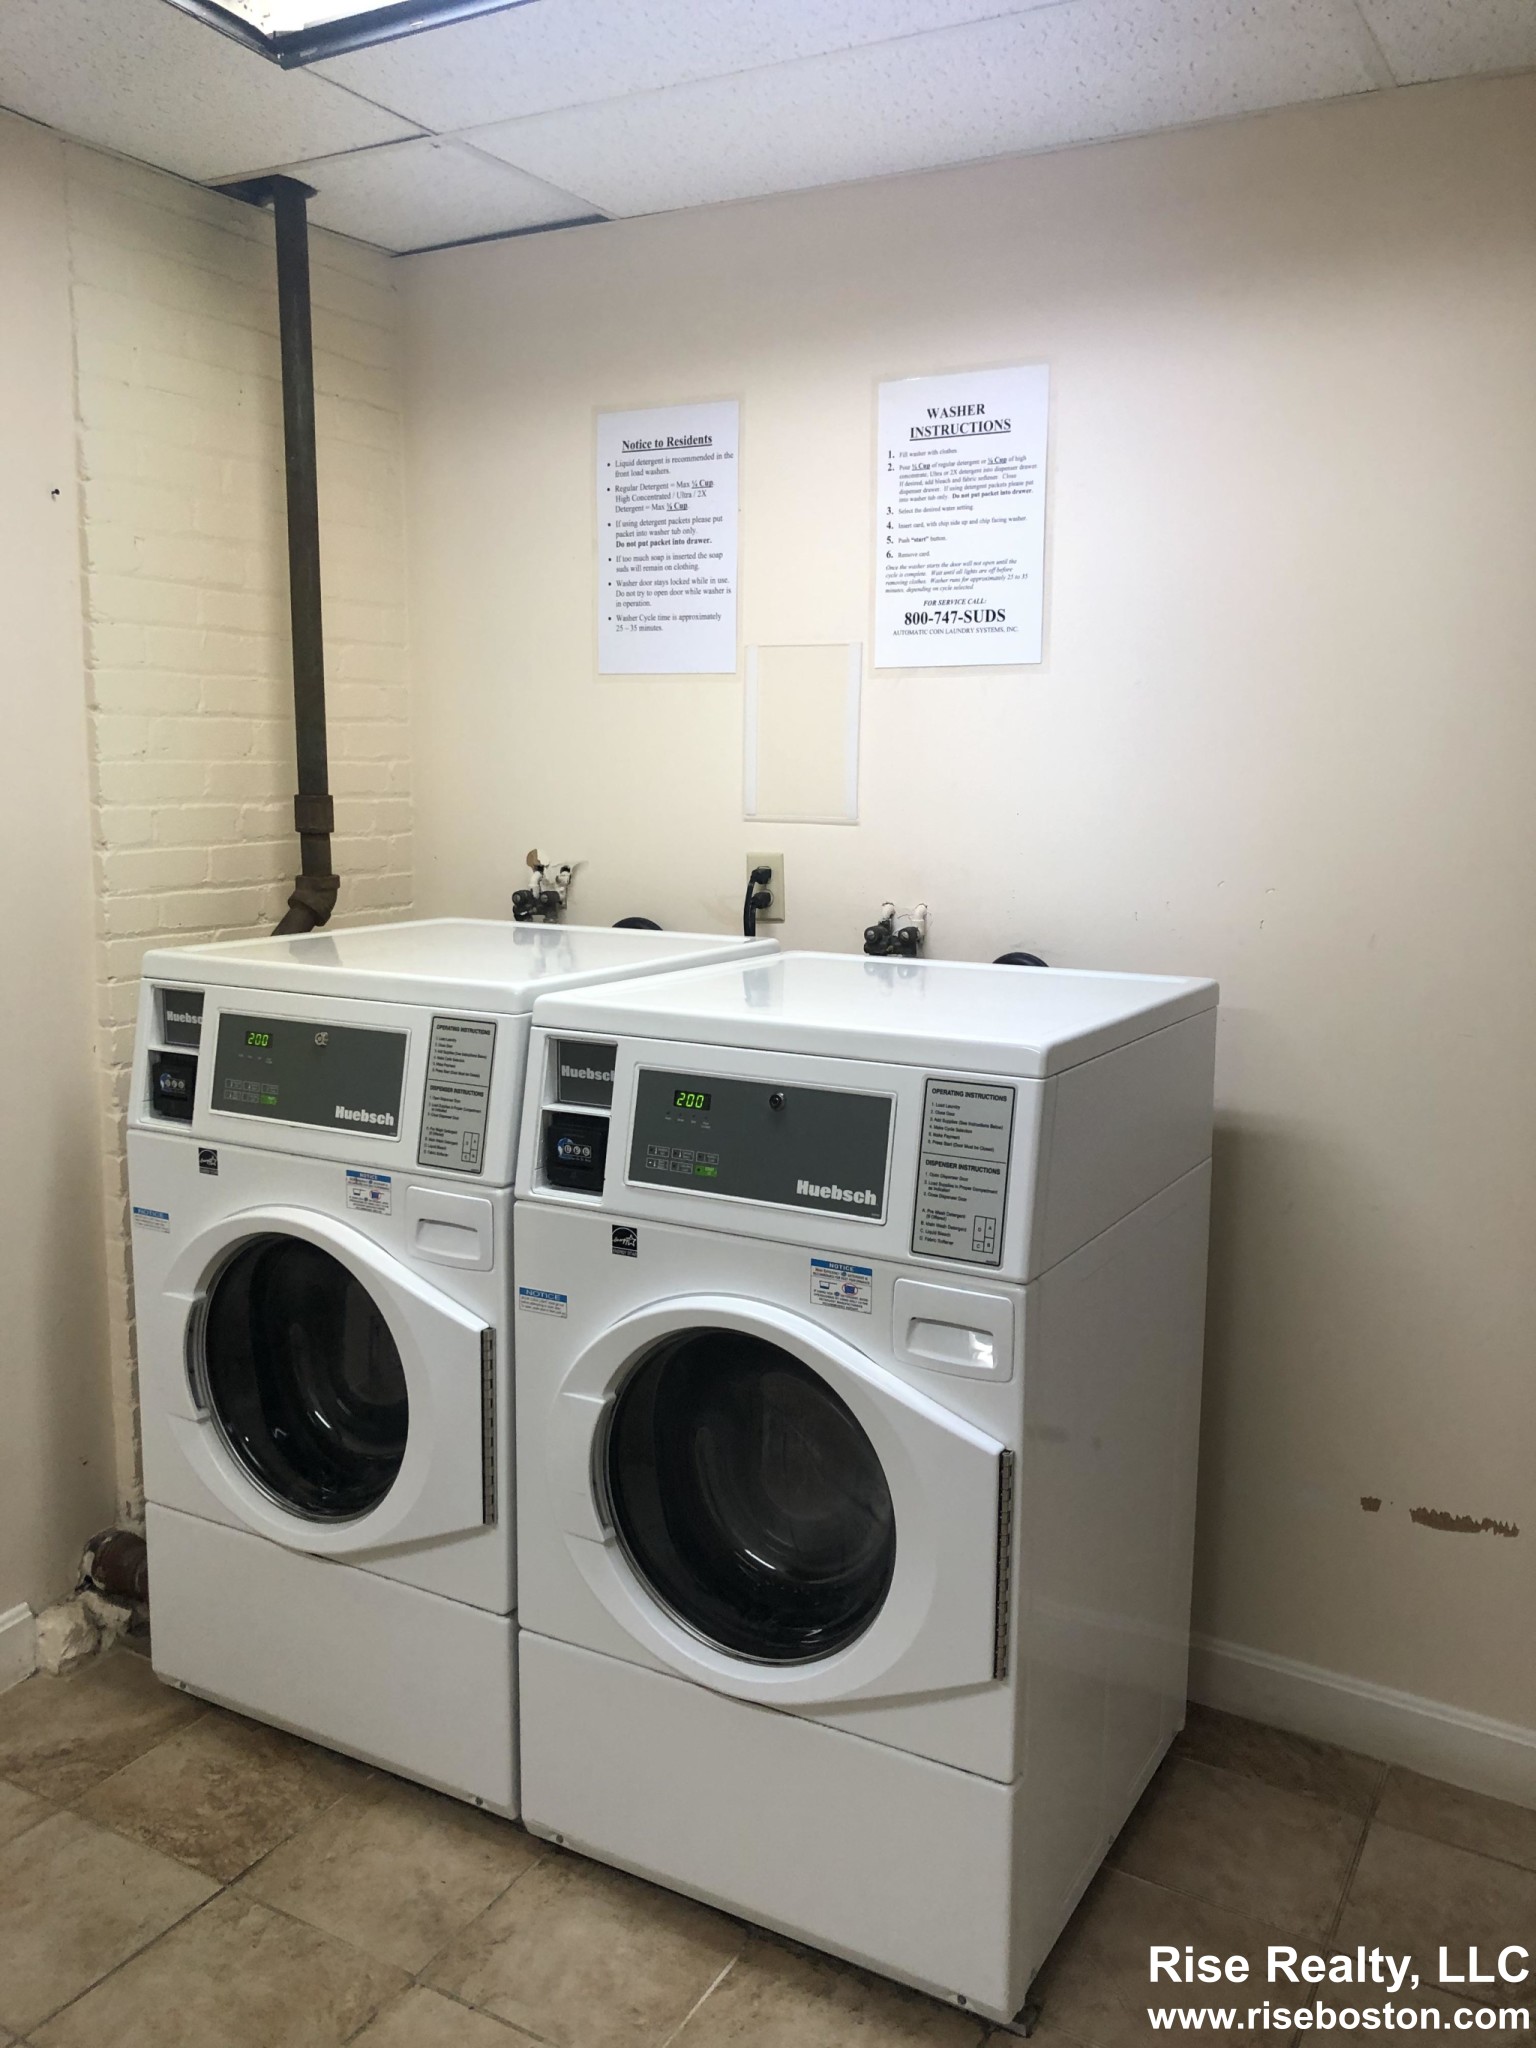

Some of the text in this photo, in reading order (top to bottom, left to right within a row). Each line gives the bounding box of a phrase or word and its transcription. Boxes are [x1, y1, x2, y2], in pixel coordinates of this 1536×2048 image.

[927, 404, 985, 419] WASHER
[910, 419, 1011, 438] INSTRUCTIONS
[622, 435, 712, 450] Notice to Residents
[615, 460, 634, 468] Liquid
[672, 453, 714, 463] recommended
[888, 450, 894, 459] 1.
[888, 463, 894, 471] 2.
[640, 483, 668, 492] Detergent
[632, 493, 671, 501] Concentrated
[616, 505, 644, 513] Detergent
[668, 517, 690, 526] packets
[692, 516, 711, 524] please
[650, 539, 670, 548] packet
[679, 612, 721, 622] approximately
[904, 609, 1006, 625] 800-747-SUDS
[248, 1032, 268, 1046] 200
[677, 1092, 704, 1108] 200
[932, 1088, 1007, 1101] OPERATING INSTRUCTIONS
[335, 1106, 394, 1126] Huebsch
[926, 1160, 1000, 1174] DISPENSER INSTRUCTIONS
[796, 1180, 876, 1205] Huebsch
[829, 1263, 853, 1271] NOTICE
[526, 1290, 560, 1300] NOTICE
